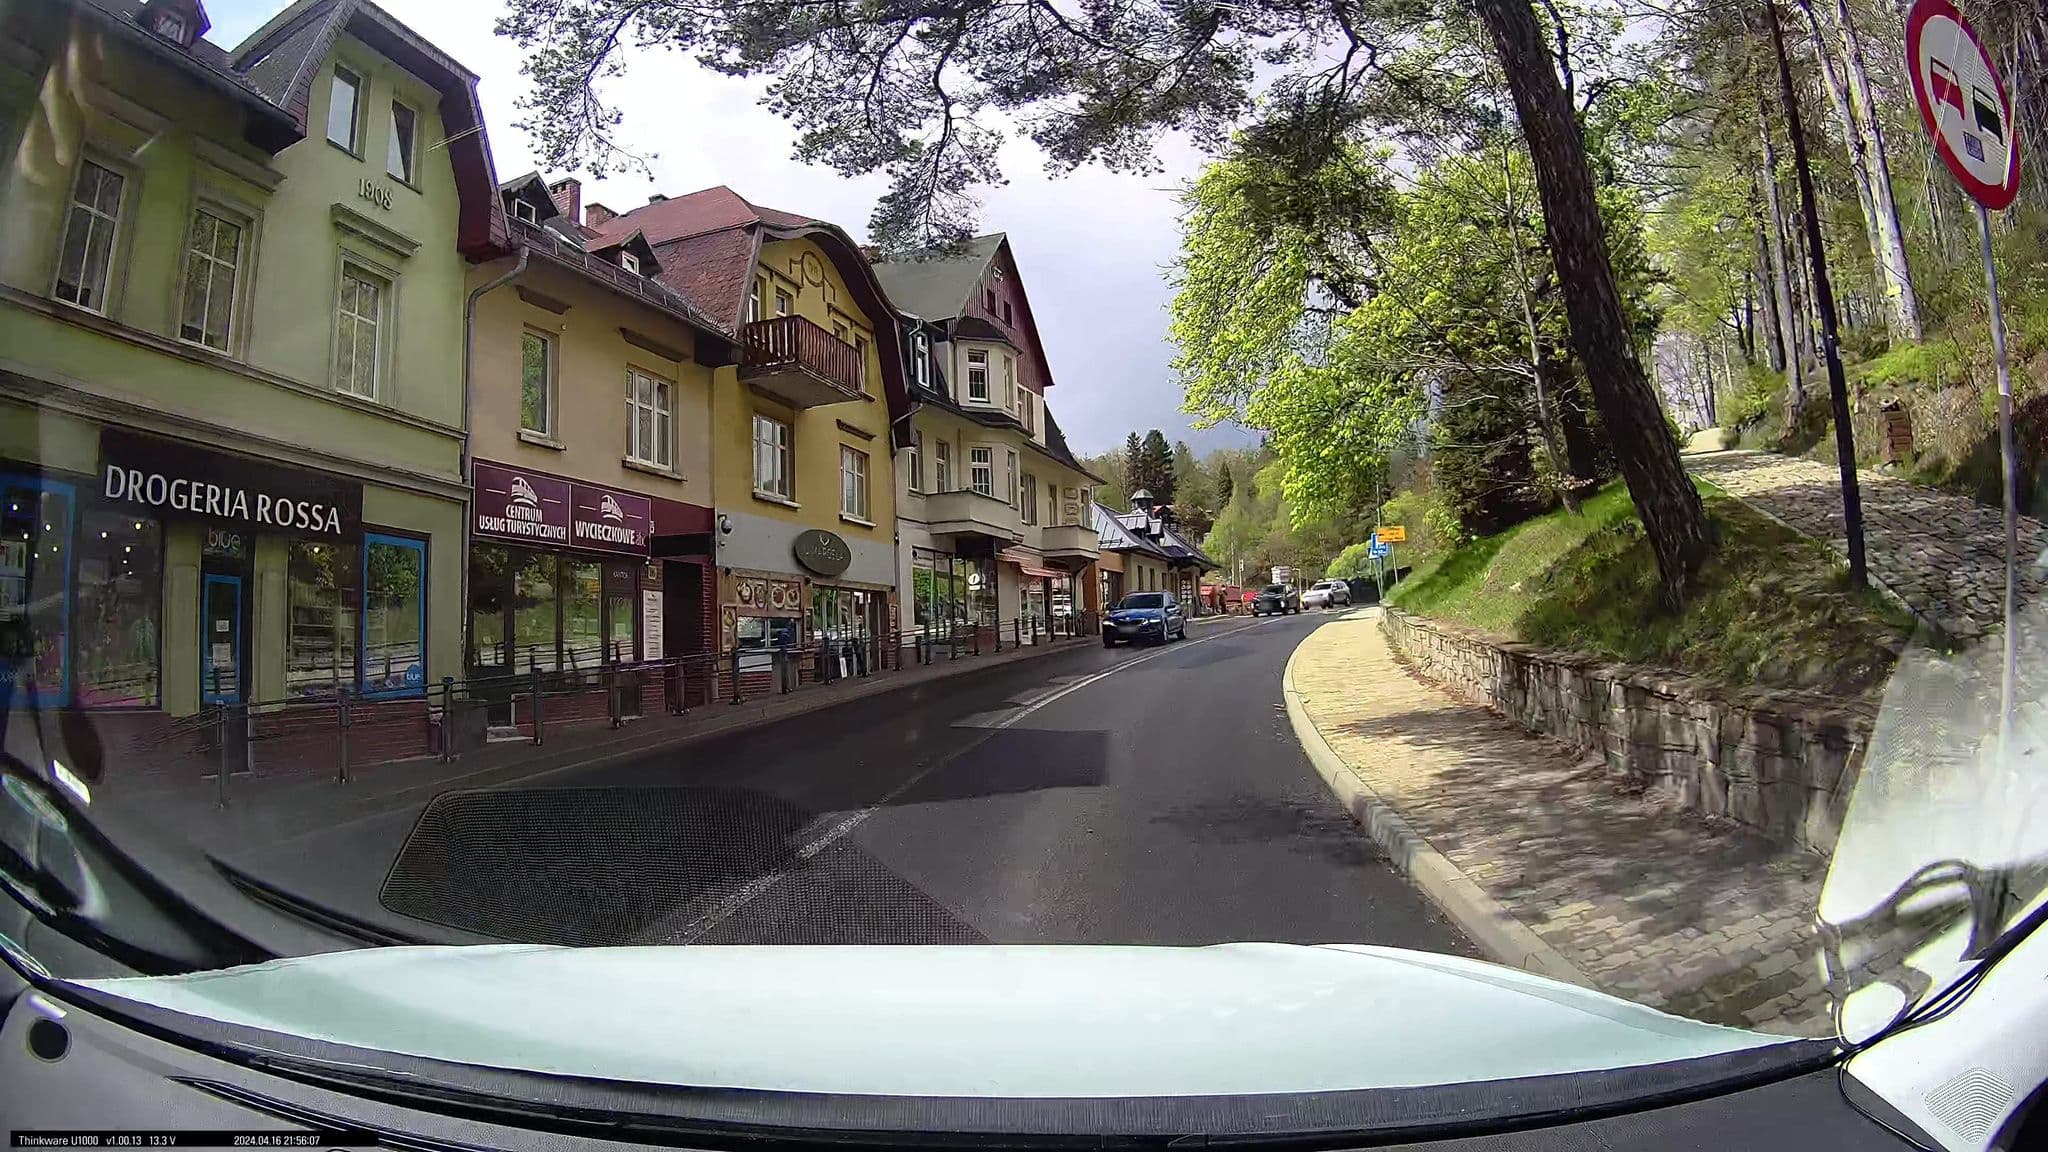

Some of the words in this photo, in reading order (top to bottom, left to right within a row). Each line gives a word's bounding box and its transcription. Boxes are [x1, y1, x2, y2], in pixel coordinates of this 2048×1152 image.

[359, 178, 392, 210] 1908
[105, 464, 249, 520] DROGERIA
[256, 493, 341, 534] ROSSA
[505, 504, 543, 523] CENTRUM
[208, 527, 241, 551] blue
[479, 514, 506, 532] USŁUG
[506, 518, 567, 540] TURYSTYCZNYCH
[575, 520, 635, 545] WYCIECZKOWE
